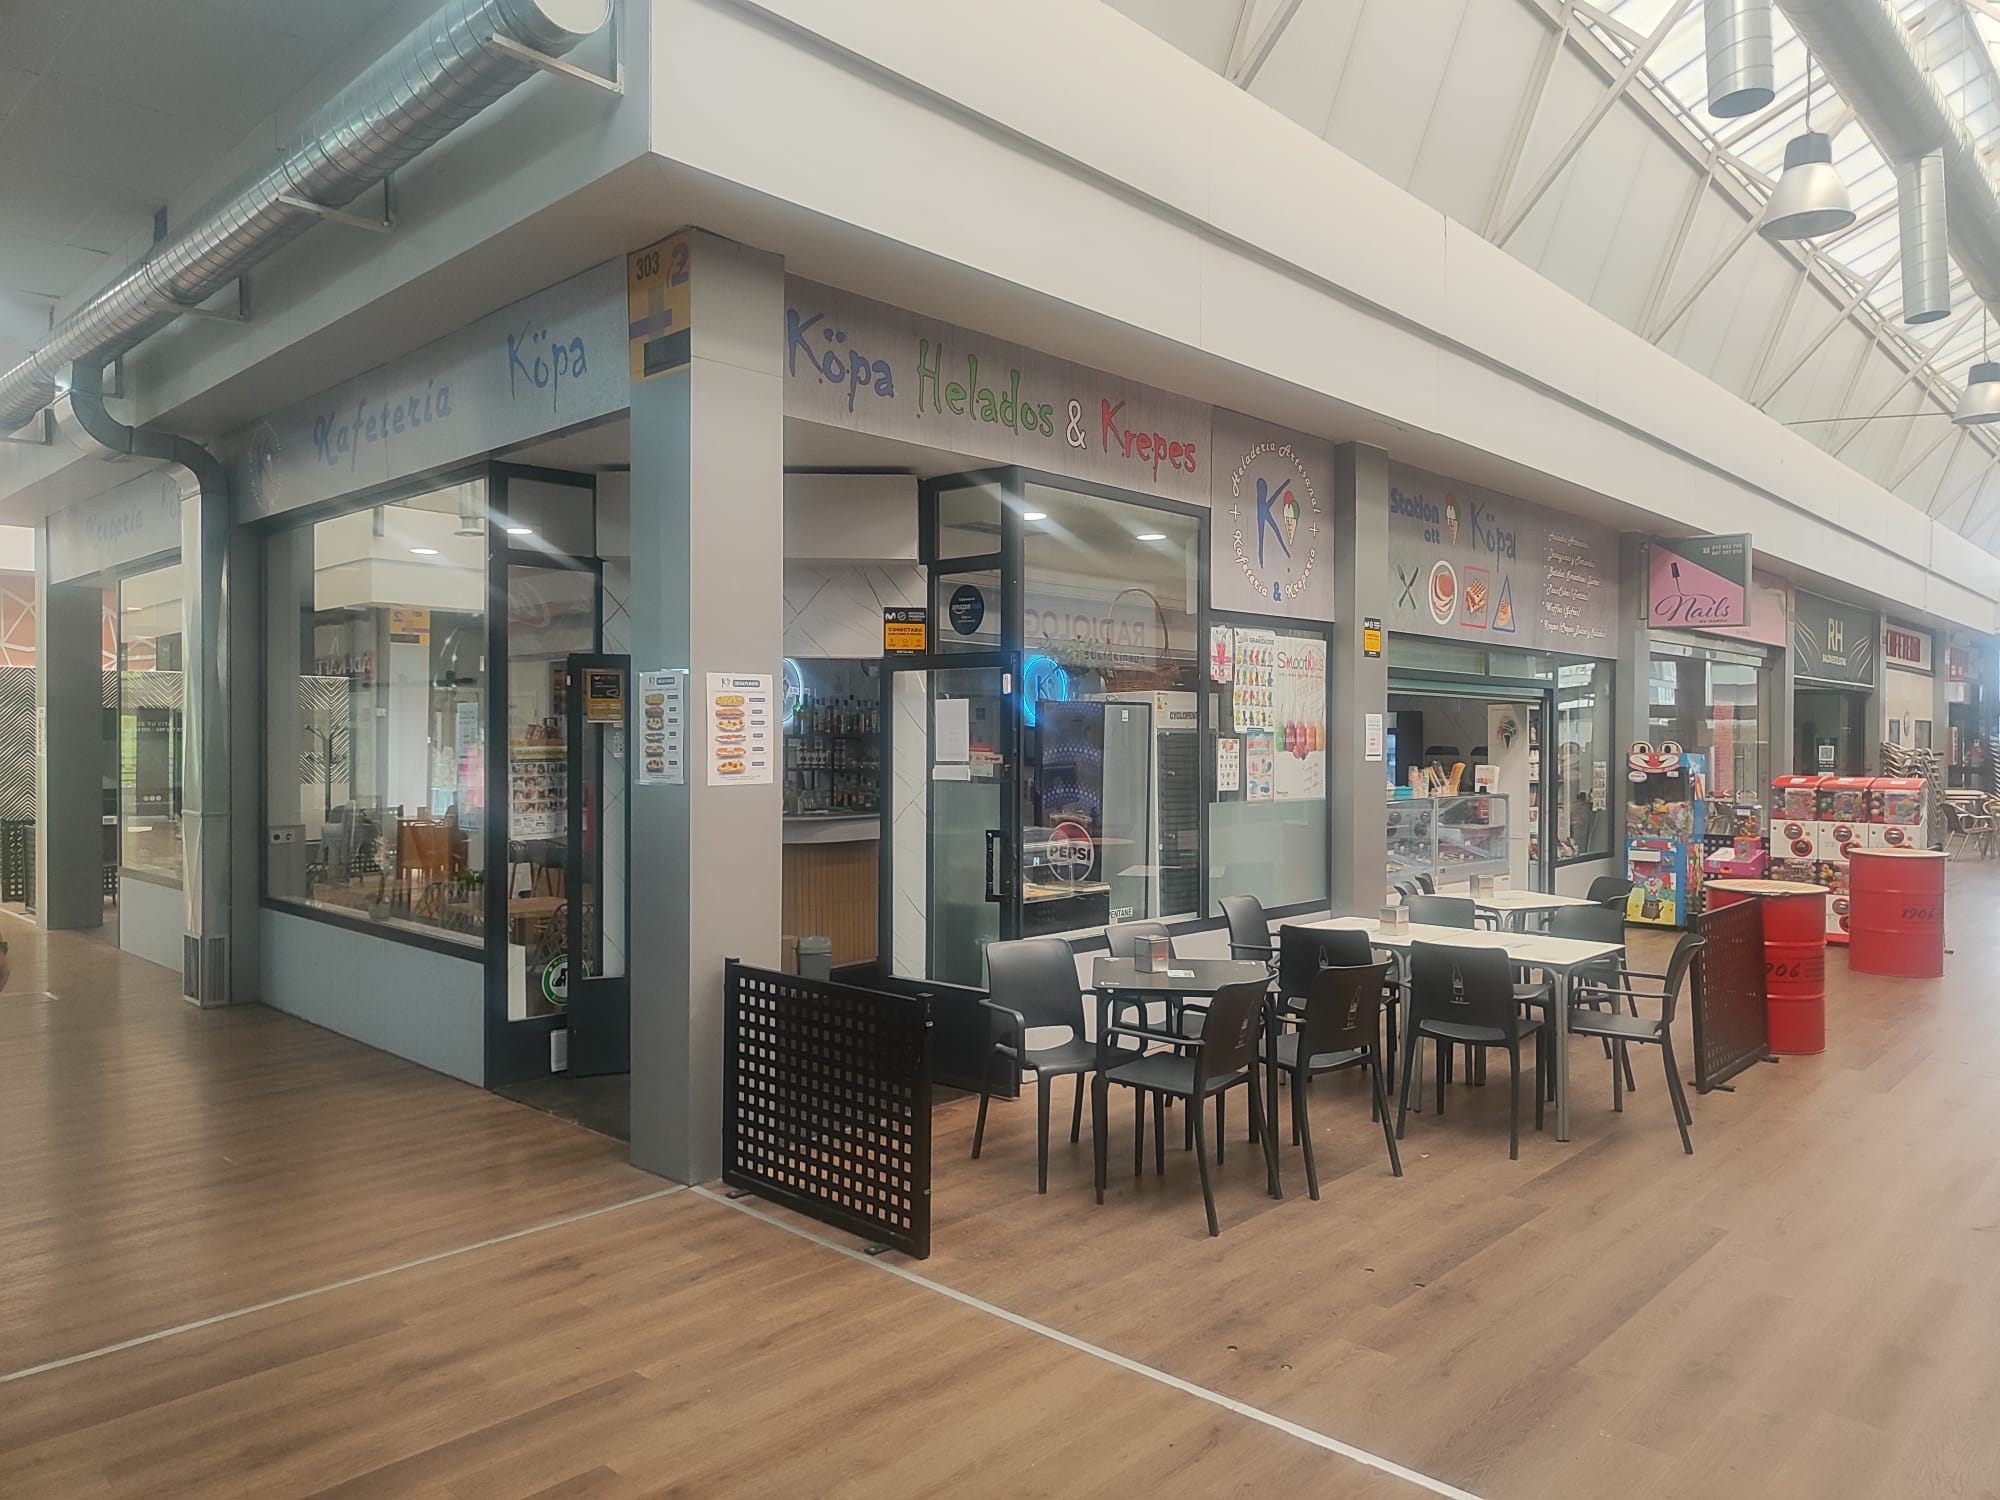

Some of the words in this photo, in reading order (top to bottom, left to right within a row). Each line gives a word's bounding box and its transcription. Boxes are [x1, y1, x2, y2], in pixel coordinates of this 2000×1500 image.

[636, 251, 660, 281] 303
[506, 321, 588, 413] Köpa
[786, 307, 895, 414] Köpa
[916, 337, 1055, 438] Helados
[1065, 398, 1087, 450] &
[1101, 398, 1197, 484] Krepes
[1278, 442, 1322, 515] Artesanal
[1390, 487, 1440, 525] Station
[1272, 580, 1283, 602] &
[1654, 593, 1730, 623] Nails
[1827, 617, 1845, 653] RH
[1048, 845, 1092, 862] PEPSI
[1901, 906, 1936, 921] 1906
[1764, 961, 1801, 979] 906
